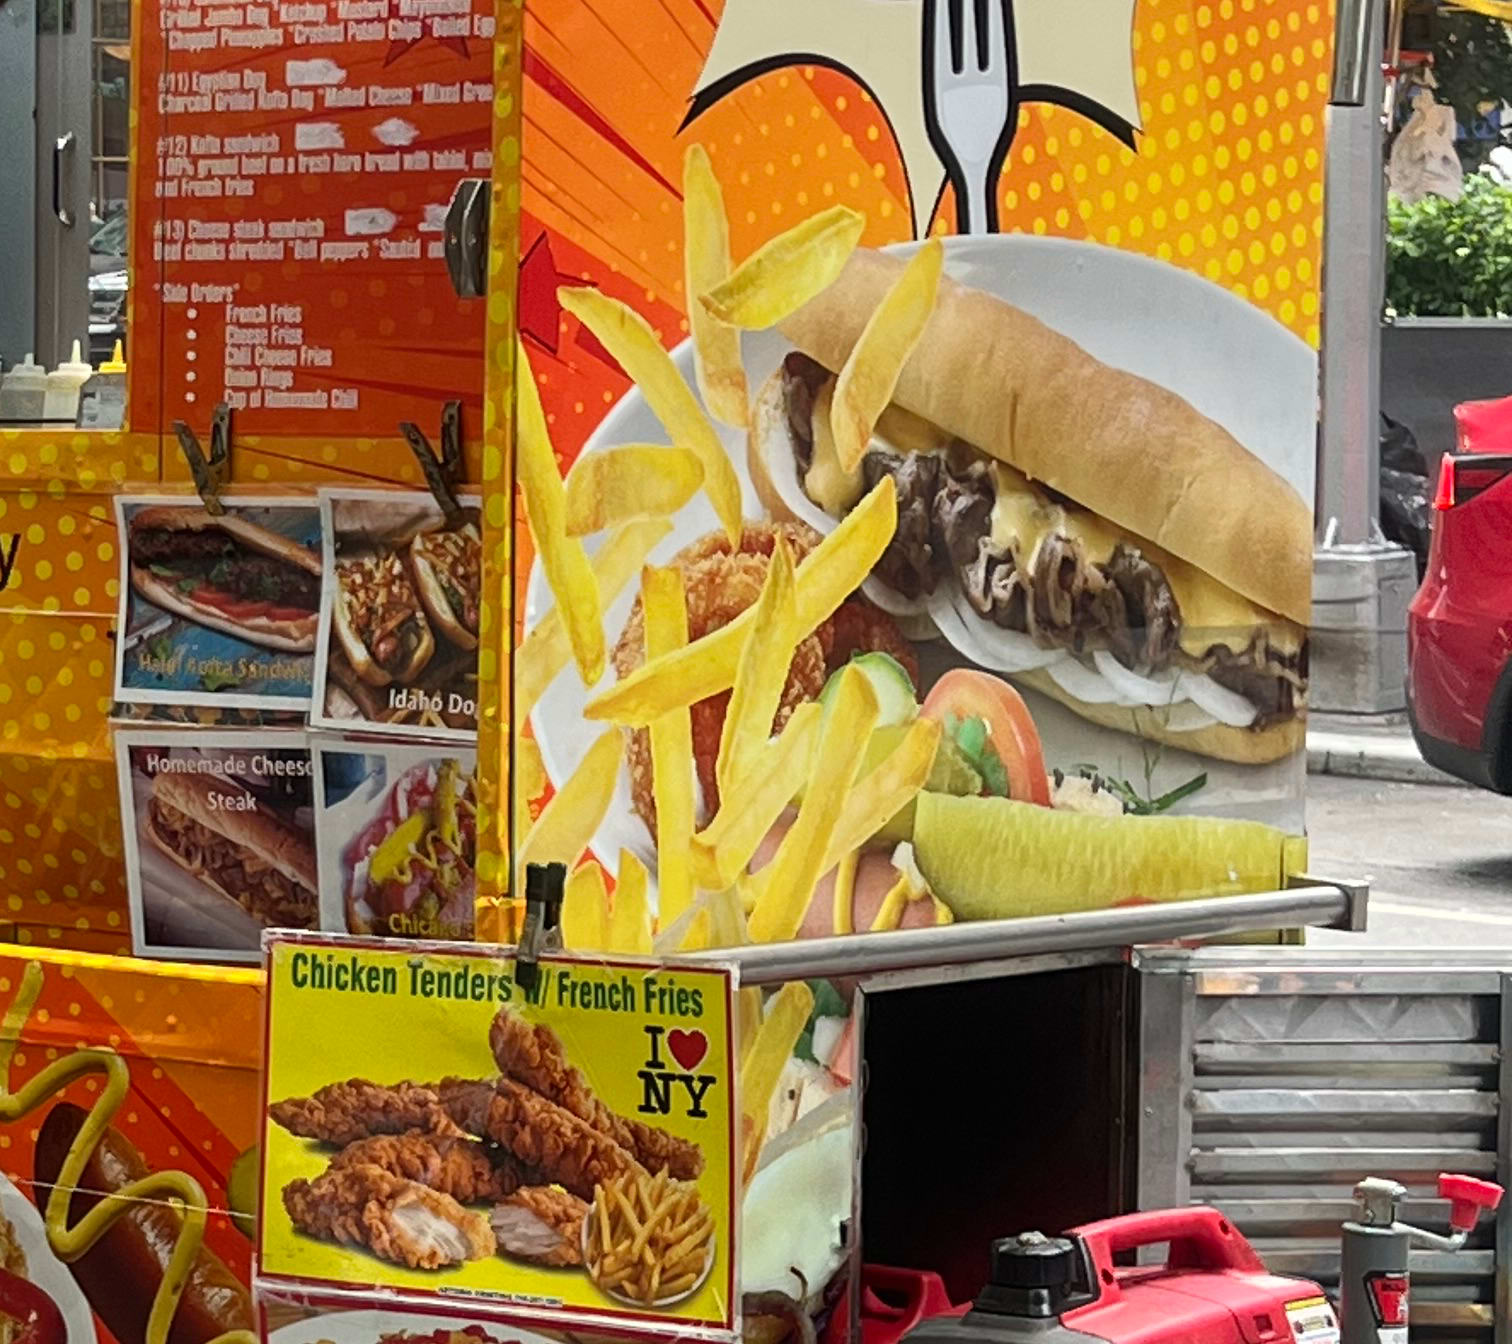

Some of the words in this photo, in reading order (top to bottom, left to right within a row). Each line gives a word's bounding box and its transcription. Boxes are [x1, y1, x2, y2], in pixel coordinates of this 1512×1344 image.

[389, 688, 443, 713] Idaho
[147, 753, 246, 777] Homemade
[207, 791, 257, 814] Steak
[291, 951, 398, 995] Chicken
[407, 959, 513, 1003] Tenders
[557, 970, 636, 1014] French
[644, 977, 703, 1018] Fries
[644, 1025, 666, 1069] I
[637, 1071, 716, 1118] NY
